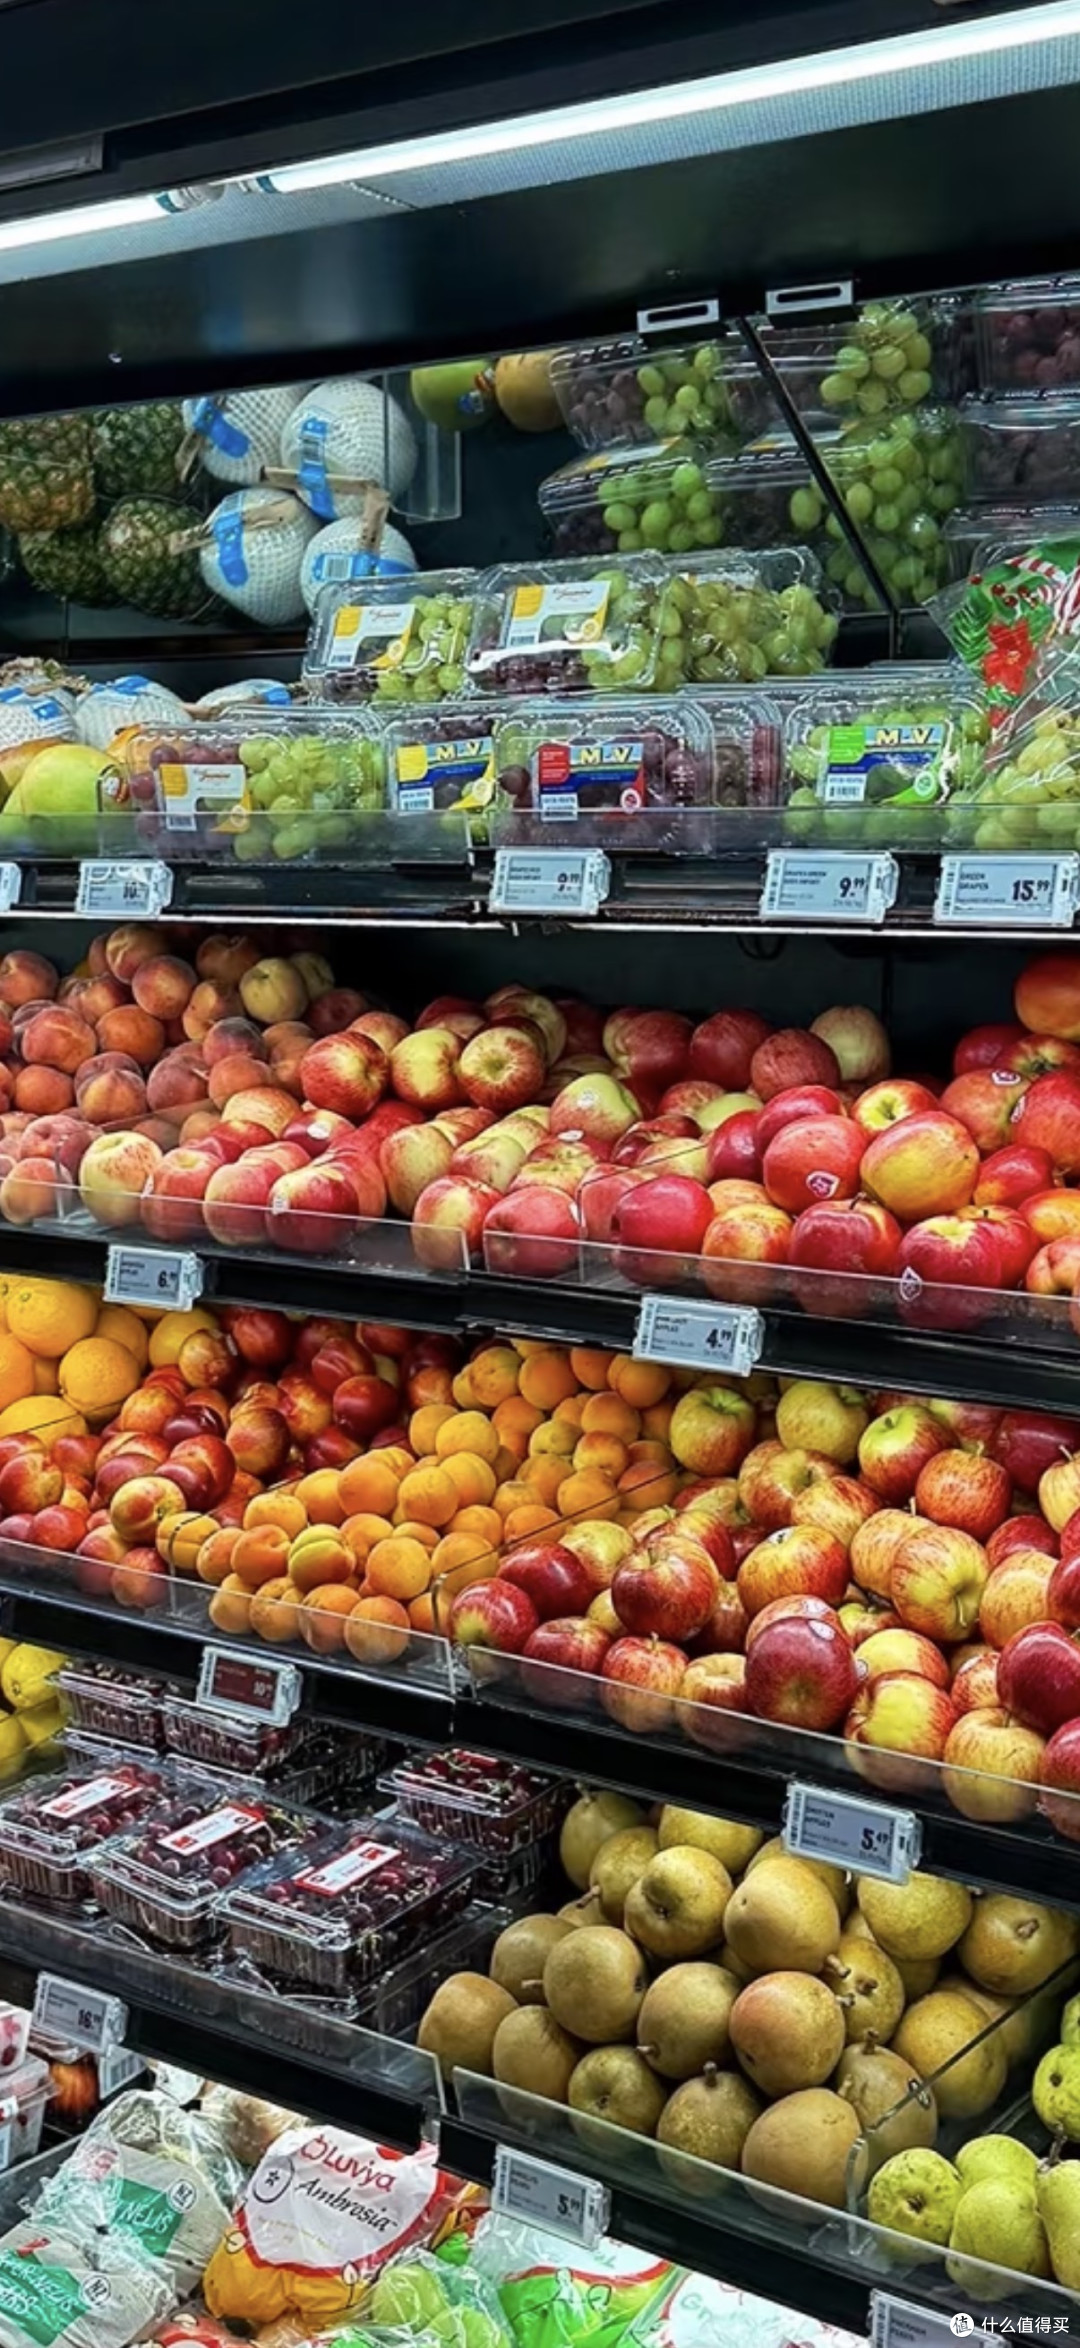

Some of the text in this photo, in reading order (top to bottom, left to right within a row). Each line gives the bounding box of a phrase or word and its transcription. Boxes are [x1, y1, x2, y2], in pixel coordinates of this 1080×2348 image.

[840, 877, 866, 898] 9.99
[1012, 879, 1051, 901] 15.99
[706, 1328, 732, 1349] 4.99
[861, 1827, 888, 1852] 5.49
[294, 2177, 393, 2232] Ambrosia
